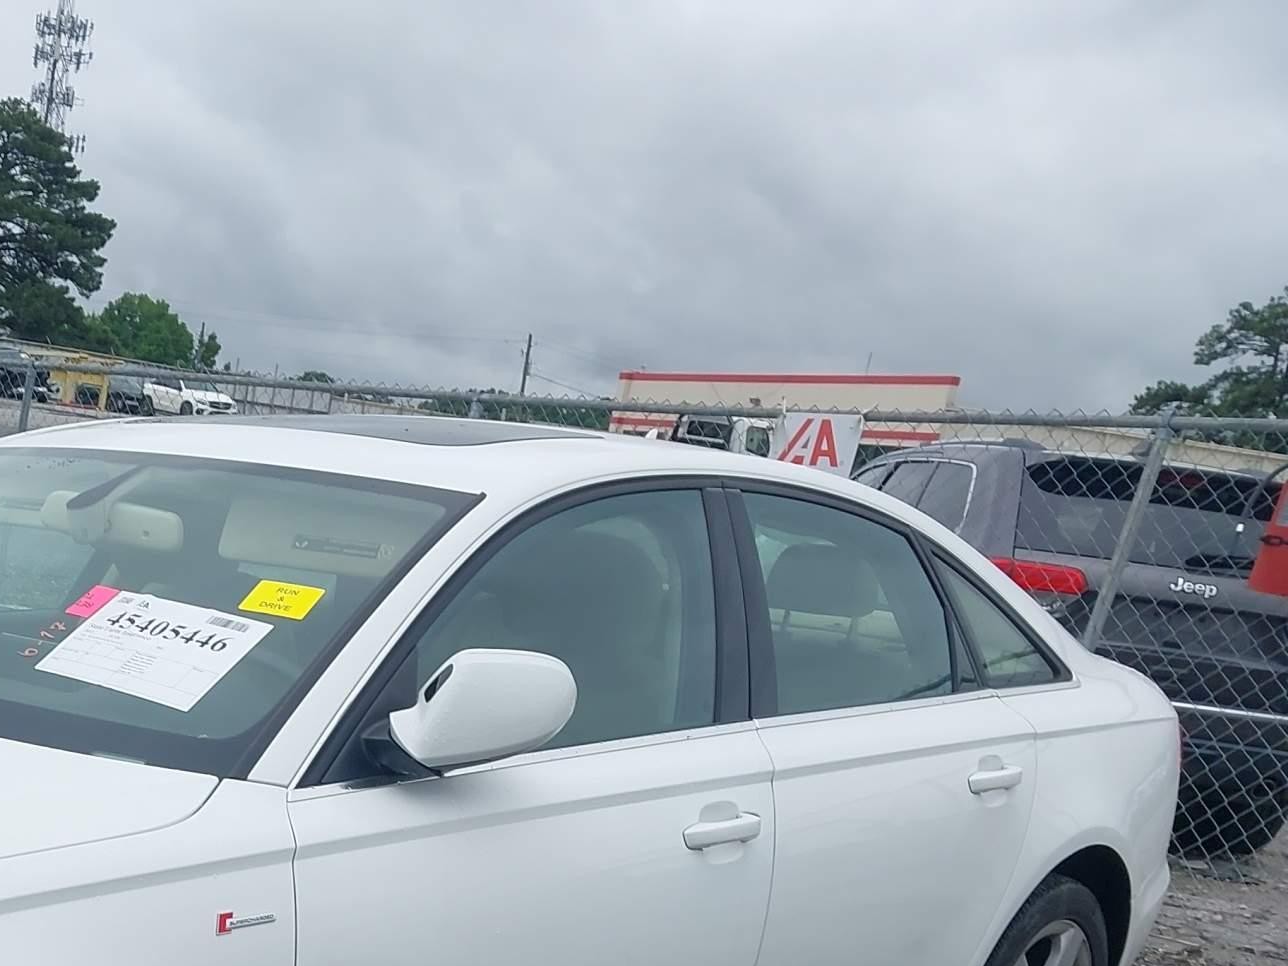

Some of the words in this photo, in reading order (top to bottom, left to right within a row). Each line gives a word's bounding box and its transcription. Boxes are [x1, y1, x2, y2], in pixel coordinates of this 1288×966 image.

[276, 587, 301, 597] RUN
[1169, 577, 1218, 599] Jeep
[258, 601, 293, 612] DRIVE
[106, 611, 235, 652] 45405446
